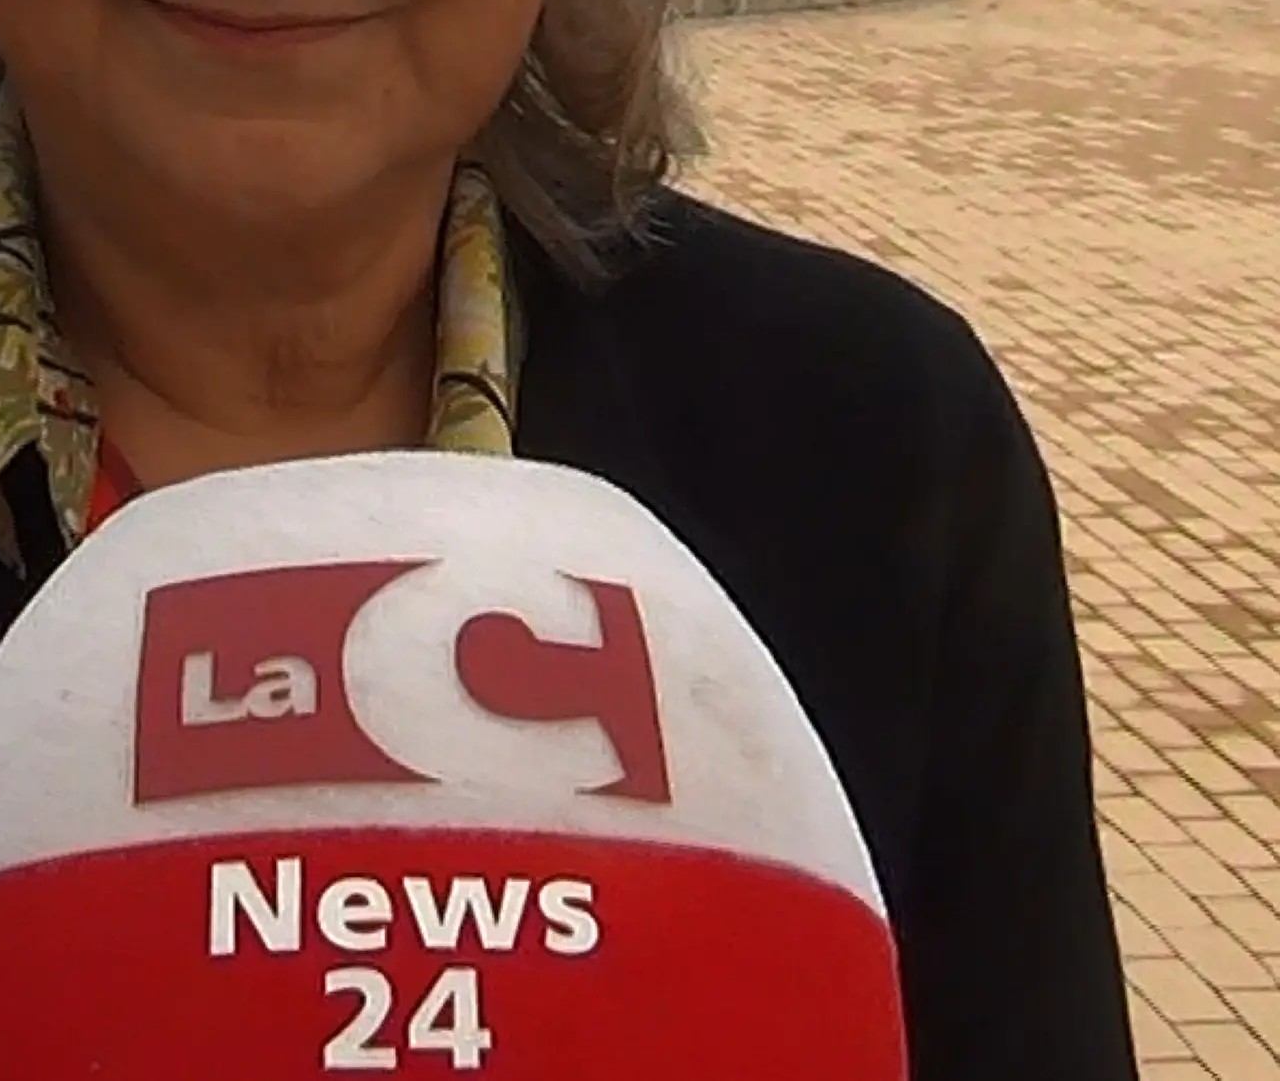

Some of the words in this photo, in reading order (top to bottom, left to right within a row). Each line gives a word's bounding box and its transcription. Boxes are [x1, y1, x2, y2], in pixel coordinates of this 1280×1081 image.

[181, 649, 318, 727] La
[208, 856, 602, 957] News
[321, 967, 493, 1071] 24
